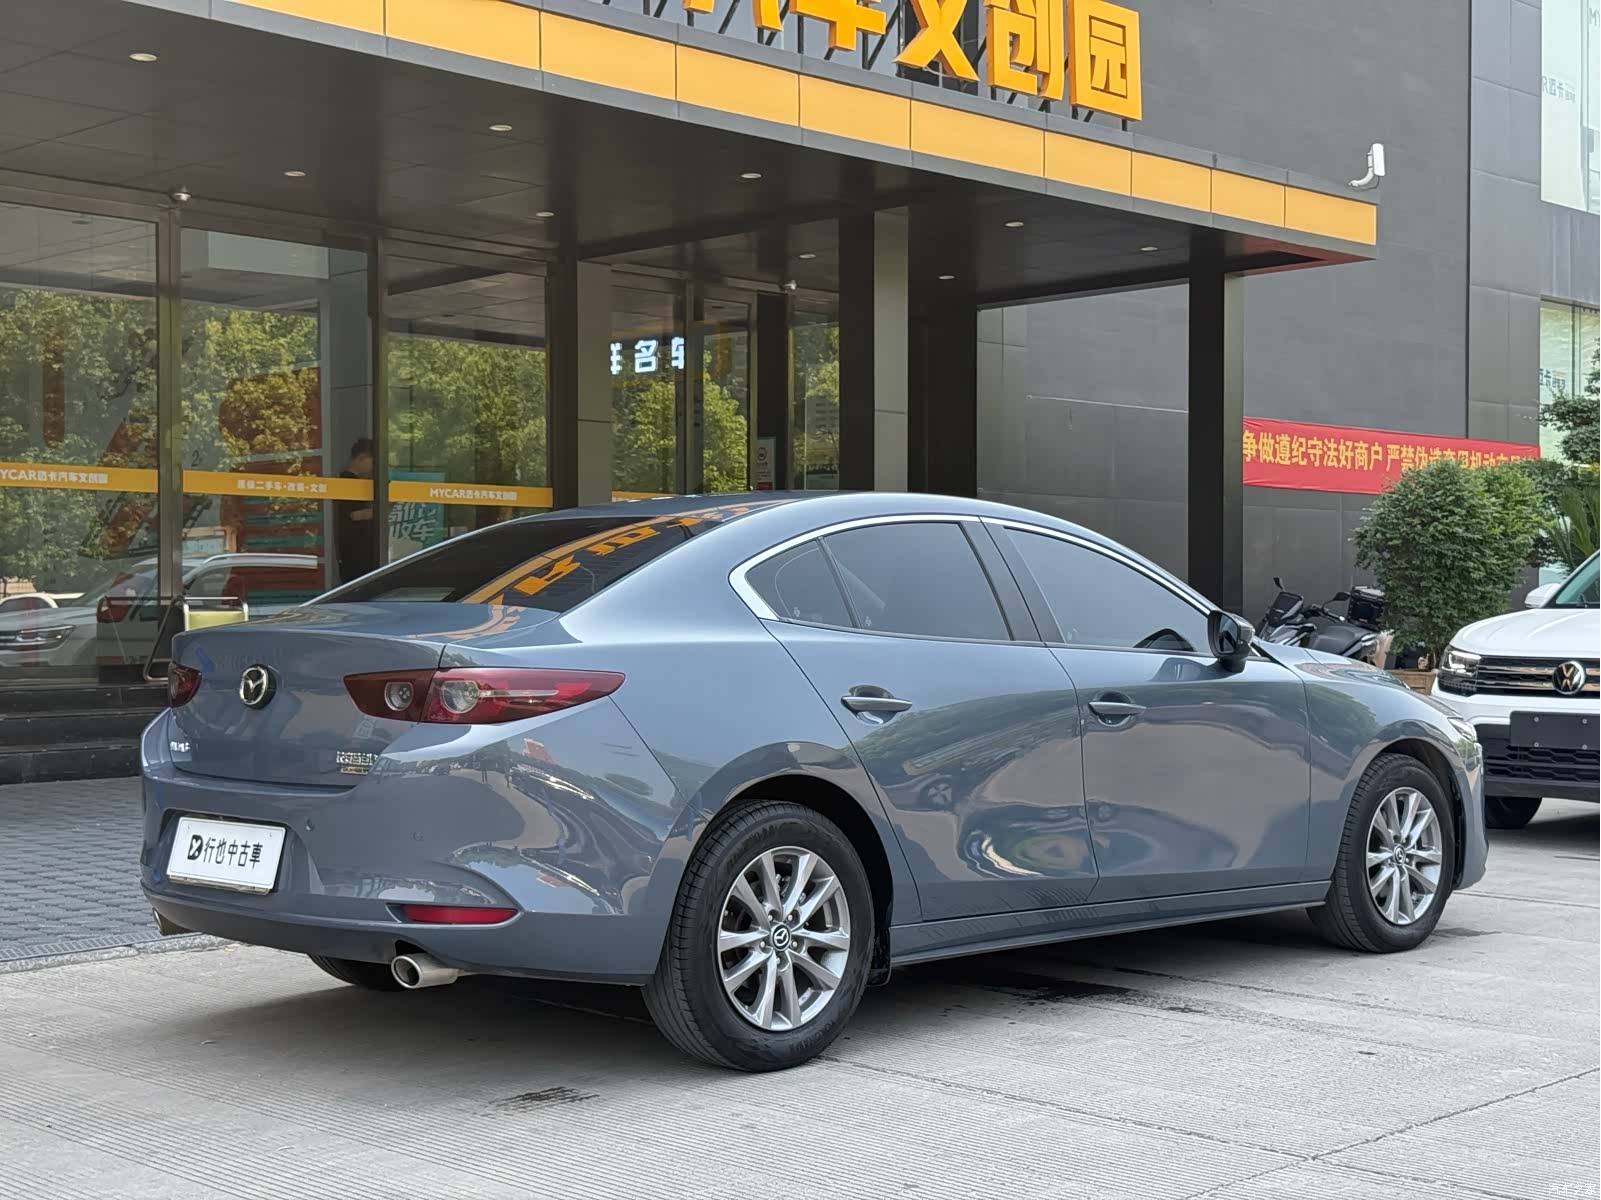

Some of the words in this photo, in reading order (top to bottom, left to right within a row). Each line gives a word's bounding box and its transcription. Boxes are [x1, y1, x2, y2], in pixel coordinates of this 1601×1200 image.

[683, 0, 1143, 121] 文创园
[1243, 429, 1383, 472] 争做遵纪守法好商户
[203, 836, 263, 869] 行也中古車
